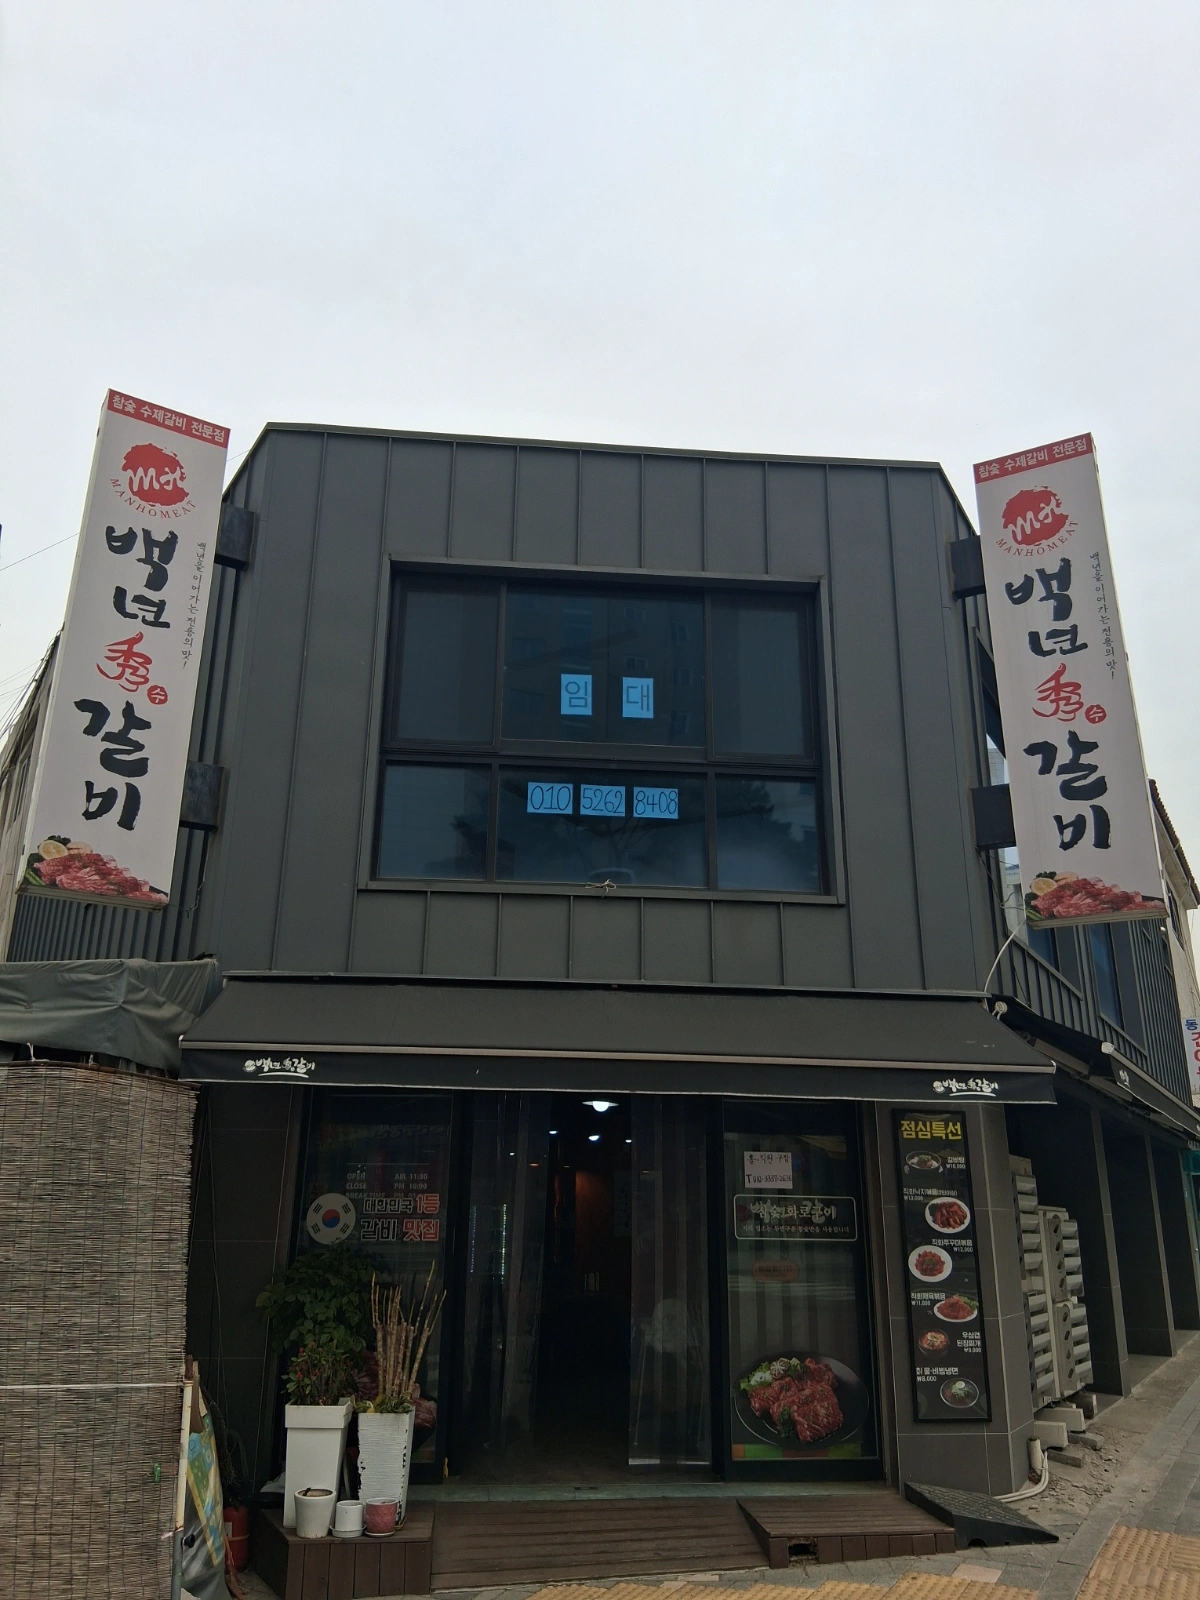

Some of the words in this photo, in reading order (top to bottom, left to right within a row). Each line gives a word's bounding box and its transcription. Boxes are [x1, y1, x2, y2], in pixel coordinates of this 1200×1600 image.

[112, 395, 137, 413] 참숯
[140, 405, 187, 431] 수제갈비
[190, 420, 225, 443] 전문점
[978, 462, 1001, 479] 참숯
[1003, 448, 1049, 471] 수제갈비
[1052, 438, 1087, 458] 전문점
[530, 785, 571, 811] 010
[582, 787, 624, 814] 5262
[634, 789, 678, 815] 8408
[900, 1120, 962, 1140] 점심특선
[346, 1172, 366, 1180] OPEN
[346, 1182, 367, 1190] CLOSE
[394, 1182, 405, 1190] PM
[363, 1197, 413, 1213] 대한민국
[416, 1194, 440, 1213] 1등
[360, 1218, 398, 1242] 갈비
[403, 1218, 440, 1242] 맛집
